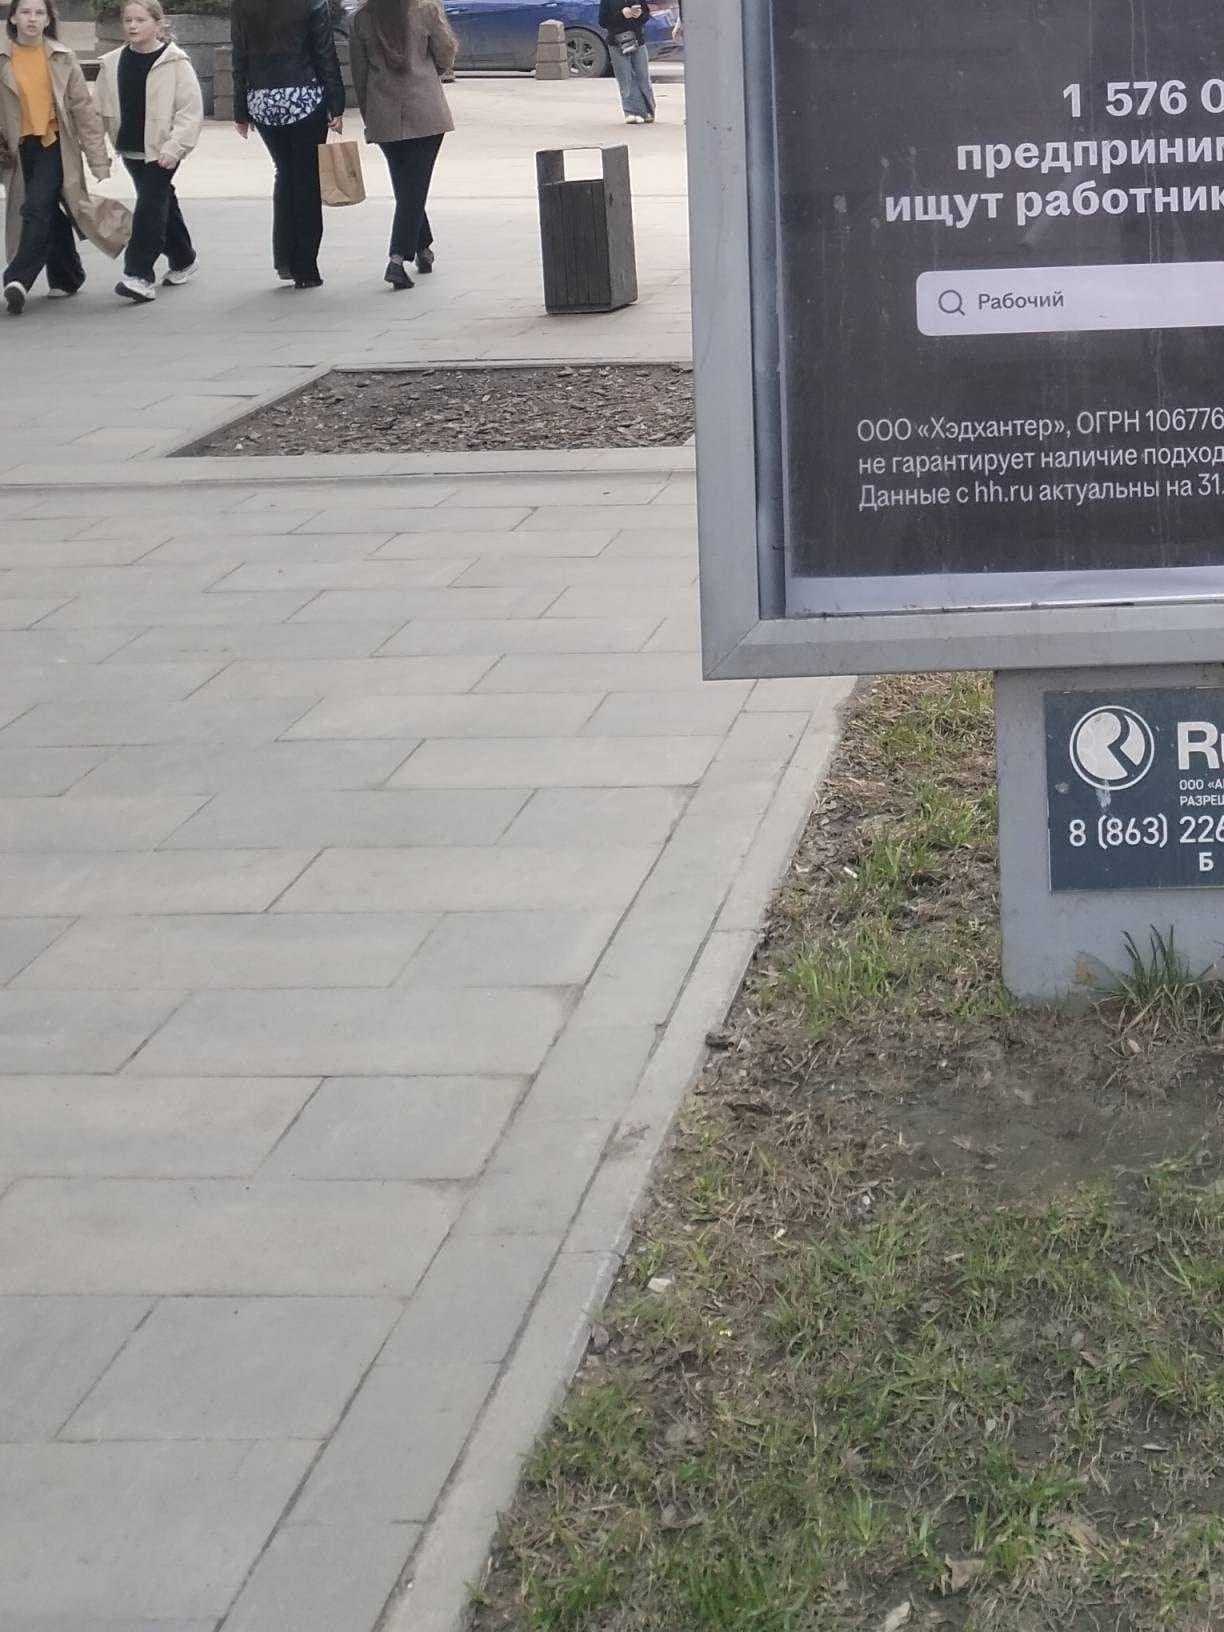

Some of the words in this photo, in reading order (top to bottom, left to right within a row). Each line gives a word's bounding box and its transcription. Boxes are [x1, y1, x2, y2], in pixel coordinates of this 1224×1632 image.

[1062, 83, 1081, 118] 1
[1105, 79, 1188, 117] 576
[885, 192, 1004, 229] ищут
[978, 290, 1064, 310] Рабочий
[857, 417, 912, 442] ООО
[917, 416, 1071, 442] «Хэдхантер»,
[1076, 410, 1140, 434] ОГРН
[858, 457, 886, 475] не
[892, 452, 1036, 478] гарантирует
[1041, 448, 1138, 468] наличие
[858, 484, 951, 511] Данные
[955, 486, 969, 504] с
[975, 480, 1033, 503] hh.ru
[1039, 480, 1160, 506] актуальны
[1166, 479, 1193, 497] на
[1179, 778, 1205, 791] ООО
[1069, 819, 1087, 847] 8
[1097, 812, 1168, 850] (863)
[1198, 851, 1214, 872] Б
